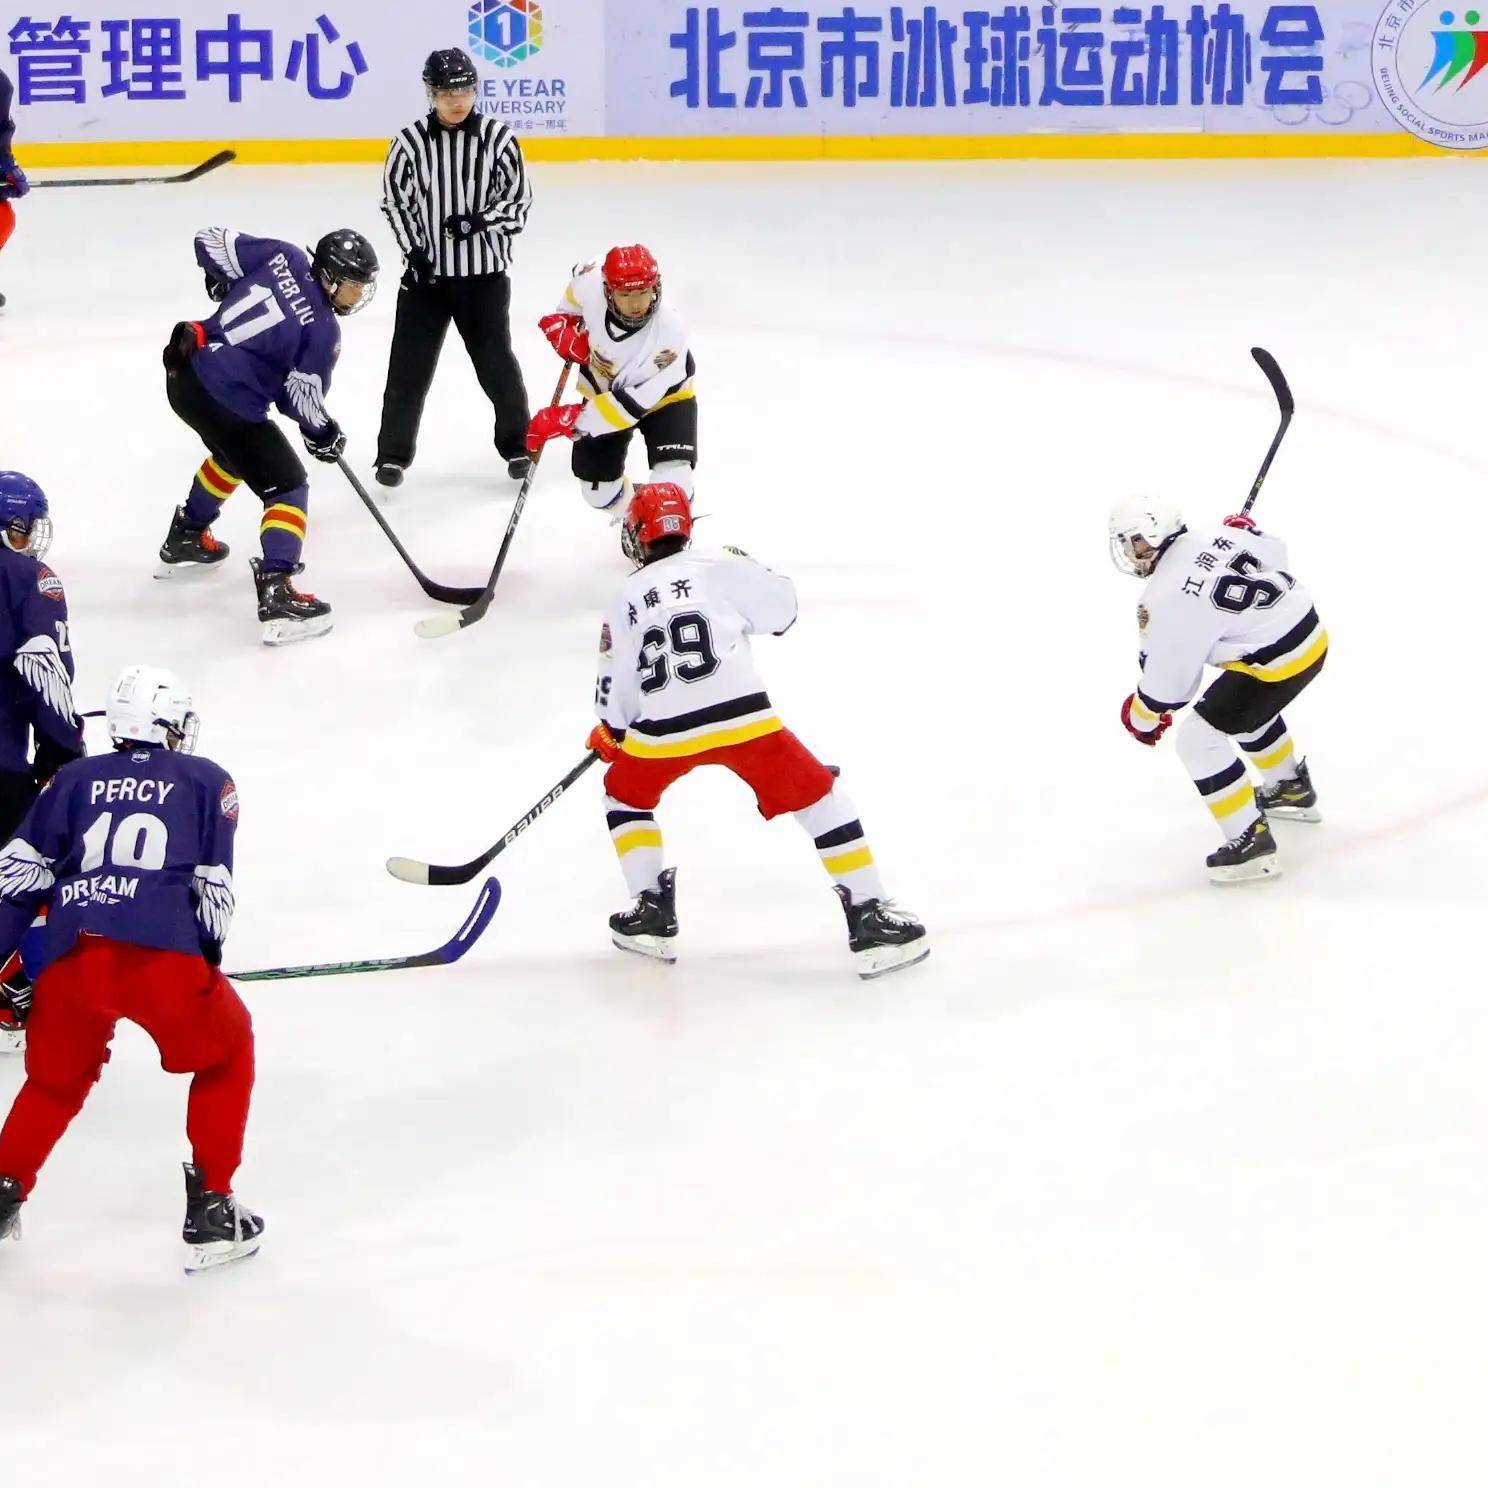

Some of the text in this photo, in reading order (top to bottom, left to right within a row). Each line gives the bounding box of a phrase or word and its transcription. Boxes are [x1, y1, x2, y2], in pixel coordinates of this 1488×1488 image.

[497, 12, 511, 46] 1
[669, 5, 1325, 109] 北京市冰球运动协会
[474, 100, 566, 114] NIVERSARY
[502, 79, 566, 98] YEAR
[1379, 66, 1399, 104] BEIJING
[1396, 103, 1426, 132] SOCIAL
[1427, 126, 1466, 143] SPORTS
[267, 252, 315, 327] PETER LIU
[219, 282, 287, 347] 17
[90, 776, 175, 805] PERCY
[80, 811, 169, 873] 10
[61, 873, 140, 908] DREAM
